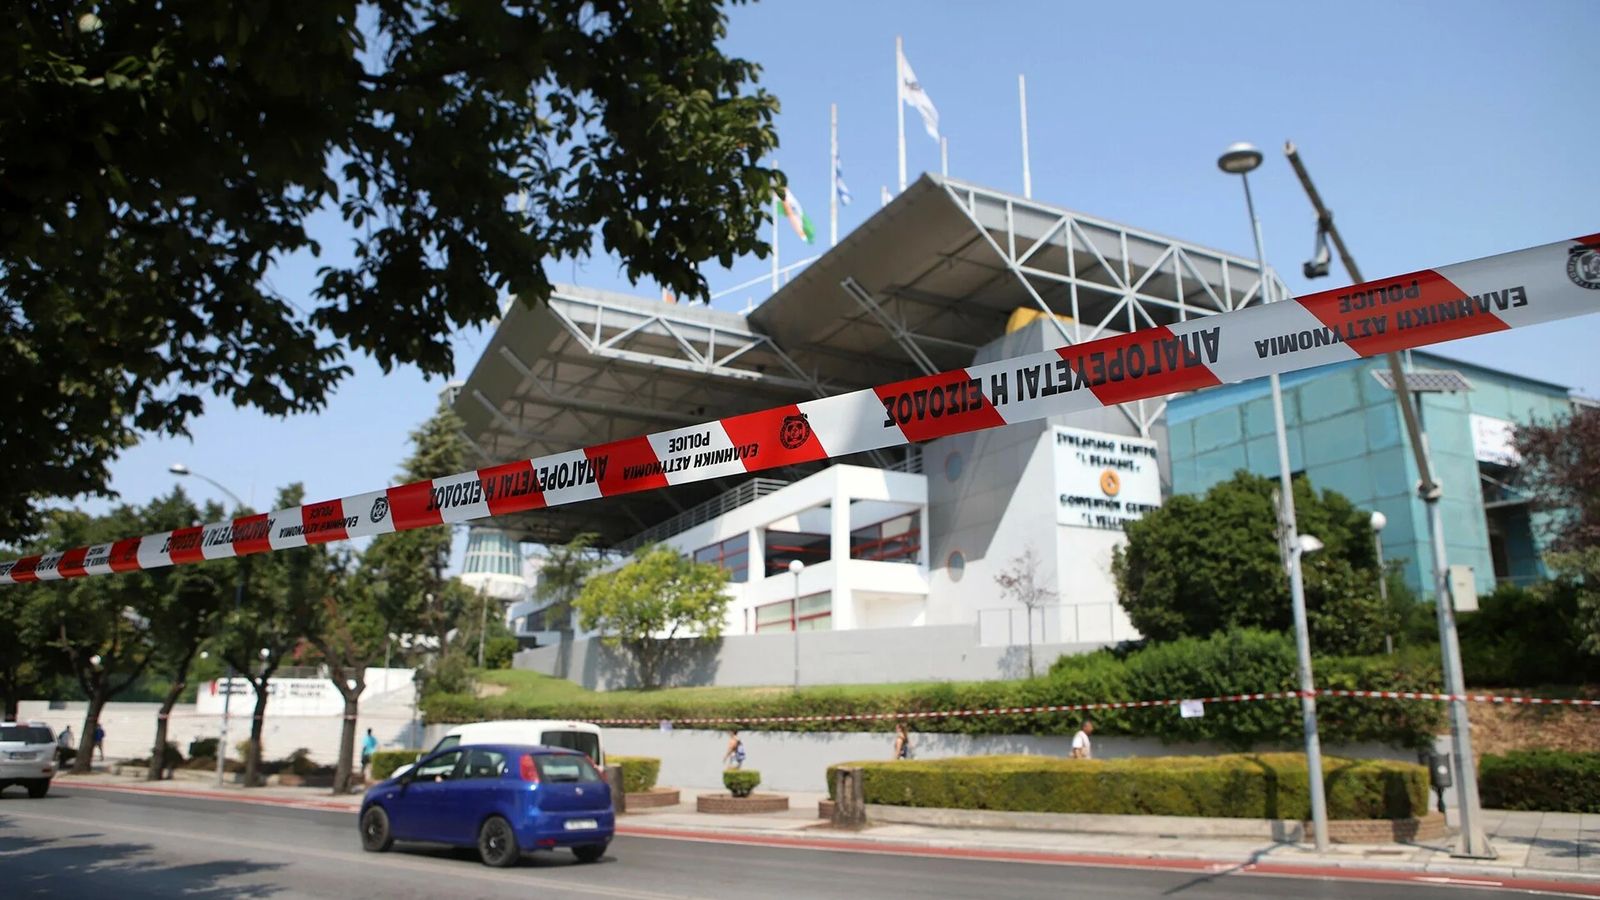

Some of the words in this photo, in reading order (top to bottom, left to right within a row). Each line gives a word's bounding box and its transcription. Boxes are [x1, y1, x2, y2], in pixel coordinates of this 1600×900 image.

[1337, 280, 1420, 313] POLICE
[1397, 286, 1528, 331] ΕΛΛΗΝΙΚΗ
[1254, 315, 1387, 358] ΑΣΤΥΝΟΜΙΑ
[1015, 326, 1220, 401] ΑΠΑΓΟΡΕΥΕΤΑΙ
[882, 377, 983, 428] ΕΙΣΟΔΟΣ
[991, 372, 1009, 405] Η
[669, 431, 710, 453] POLICE
[694, 443, 759, 468] ΕΛΛΗΝΙΚΗ
[497, 455, 608, 499] ΑΠΑΓΟΡΕΥΕΤΑΙ
[623, 456, 692, 480] ΑΣΤΥΝΟΜΙΑ
[426, 480, 482, 511] ΕΙΣΟΔΟΣ
[1060, 494, 1120, 510] CONVENTION
